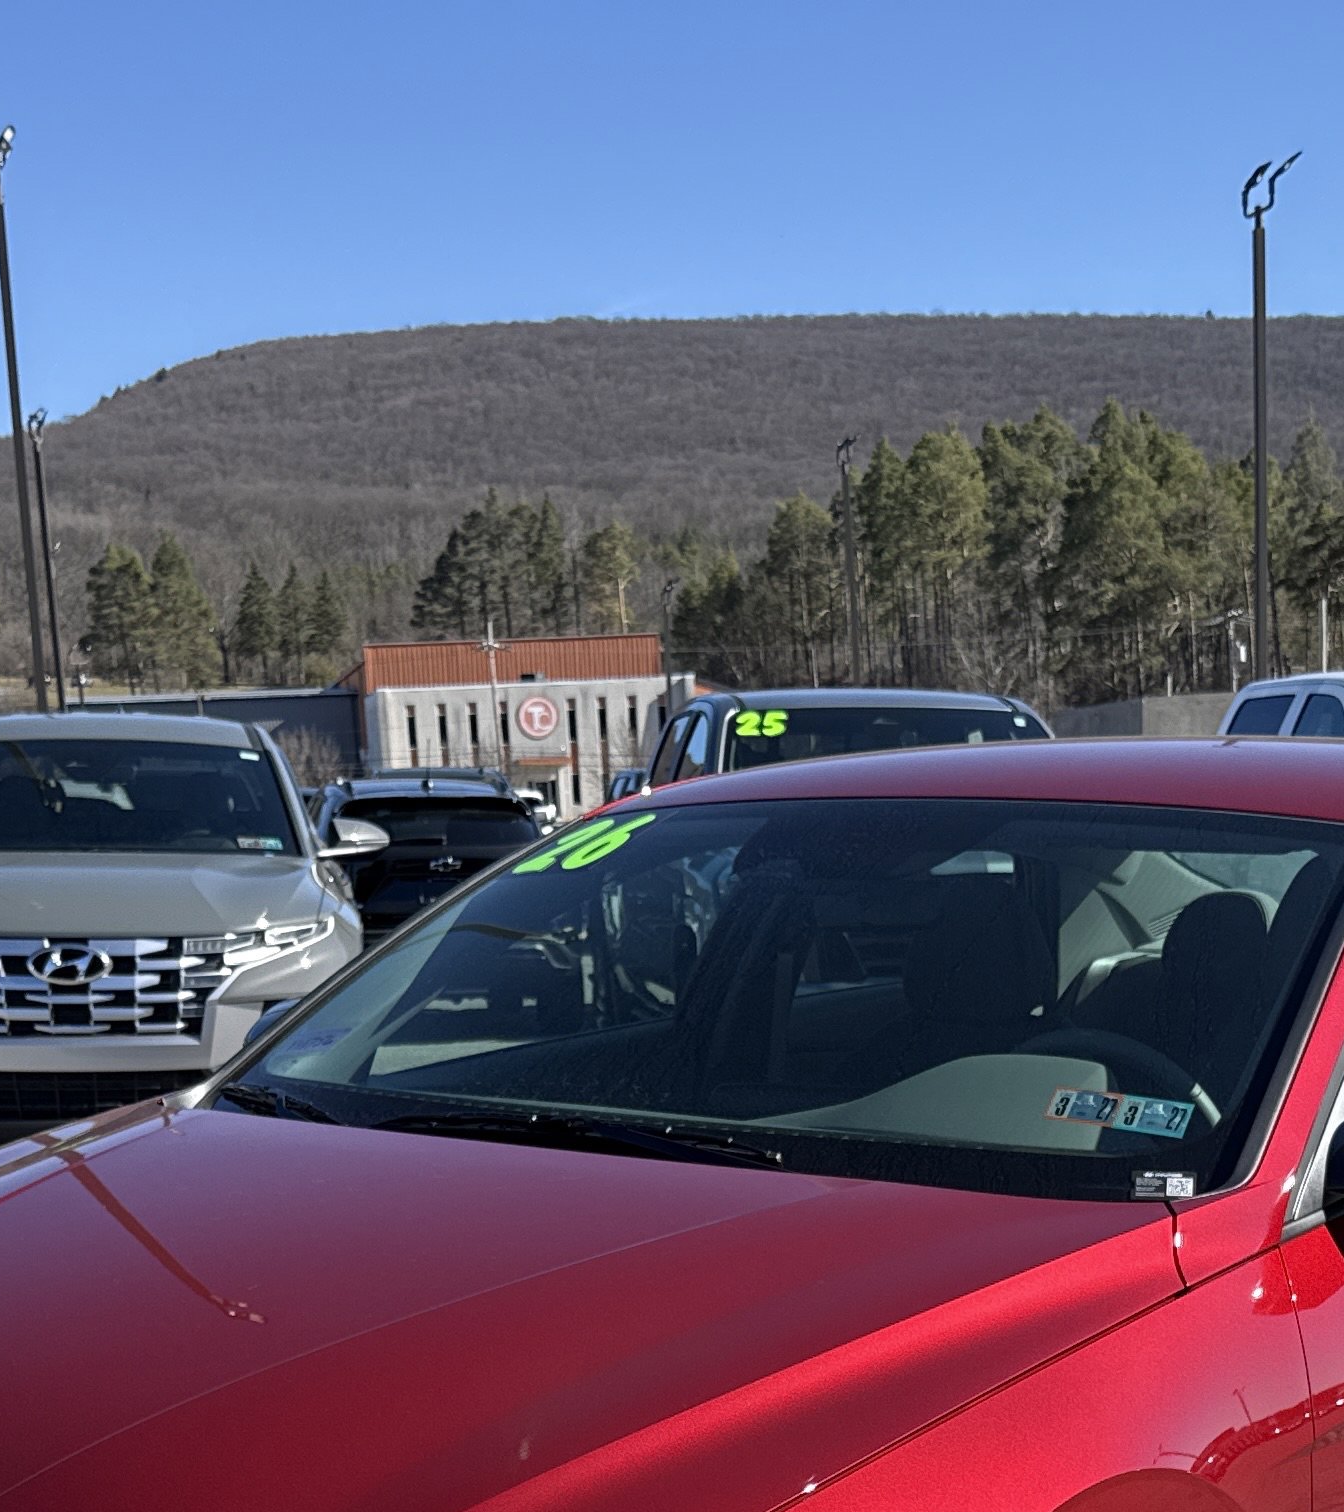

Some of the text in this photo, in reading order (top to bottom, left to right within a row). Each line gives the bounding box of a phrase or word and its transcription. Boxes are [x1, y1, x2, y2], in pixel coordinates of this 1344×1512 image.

[735, 709, 789, 737] 25
[511, 813, 656, 874] 26
[1055, 1098, 1118, 1120] 3 27
[1123, 1105, 1188, 1132] 3 27
